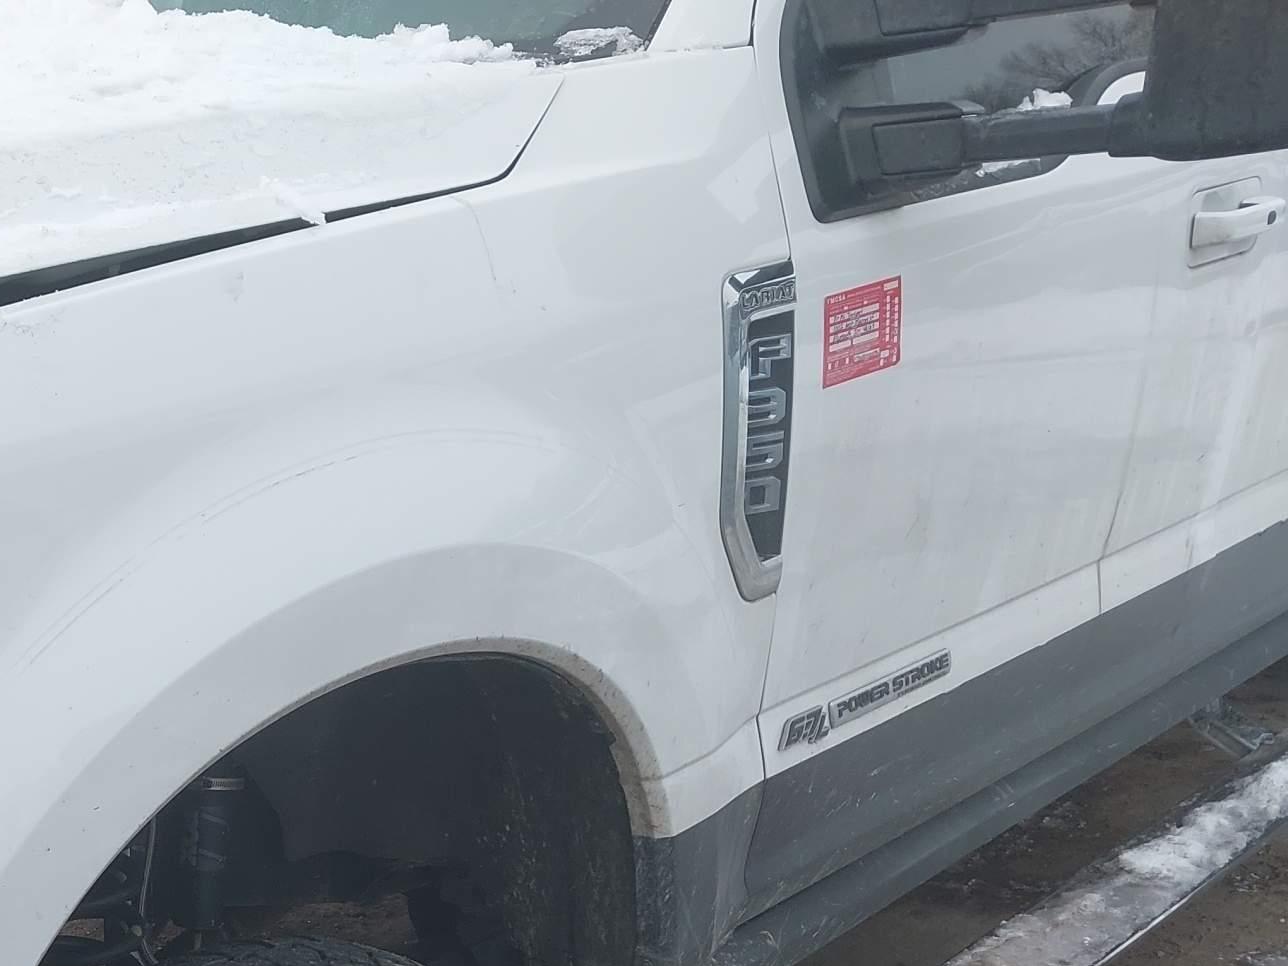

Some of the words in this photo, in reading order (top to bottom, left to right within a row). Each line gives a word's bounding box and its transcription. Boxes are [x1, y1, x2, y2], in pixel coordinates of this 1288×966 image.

[741, 281, 795, 309] LARIAT
[745, 333, 792, 516] F350
[837, 682, 890, 718] POWER
[892, 653, 949, 692] STROKE
